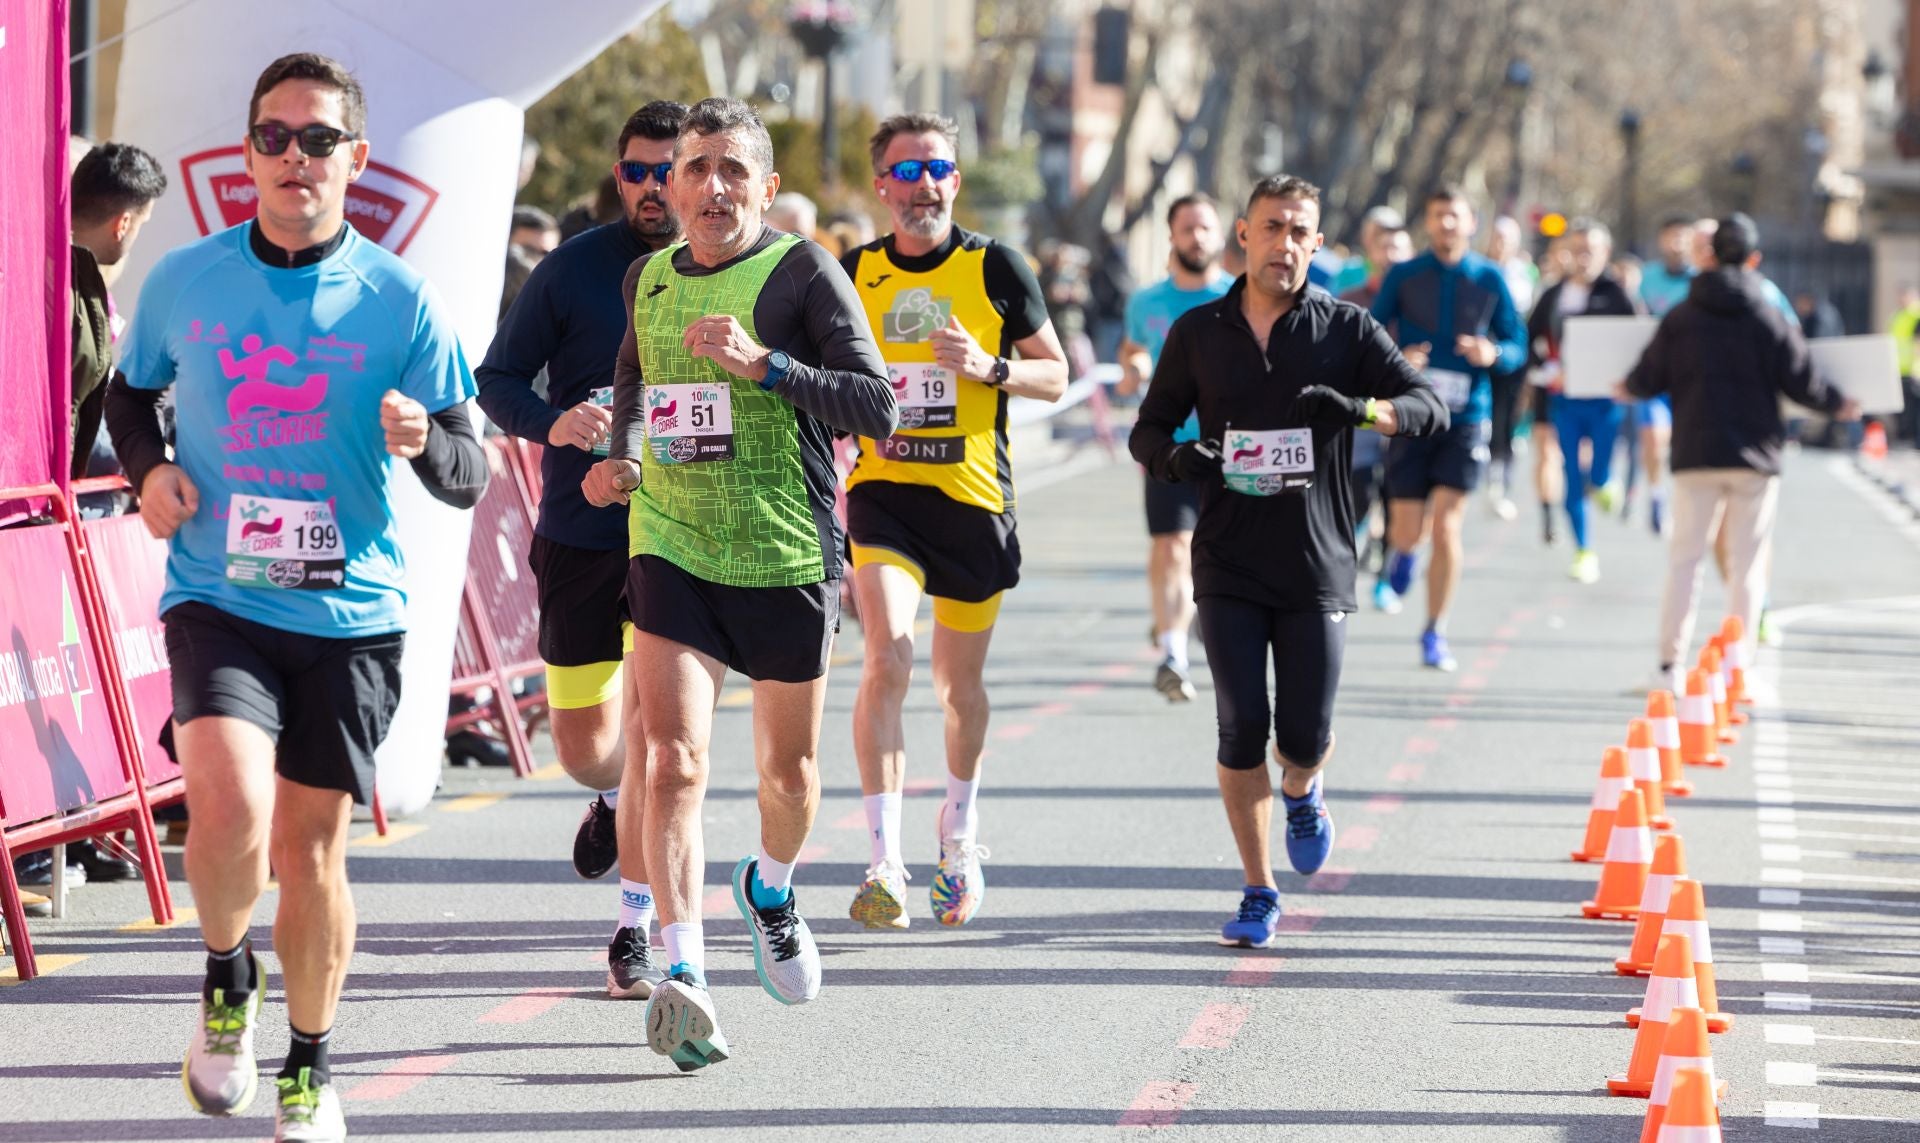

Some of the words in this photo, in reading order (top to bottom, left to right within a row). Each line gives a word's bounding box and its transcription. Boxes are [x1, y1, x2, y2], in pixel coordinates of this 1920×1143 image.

[343, 195, 393, 222] eporte
[691, 390, 718, 401] 10Km
[921, 380, 945, 399] 19
[658, 415, 679, 434] CORRE
[691, 404, 714, 428] 51
[231, 422, 256, 452] SE
[258, 412, 330, 449] CORRE
[885, 439, 949, 459] POINT
[1271, 446, 1307, 466] 216
[293, 524, 337, 550] 199
